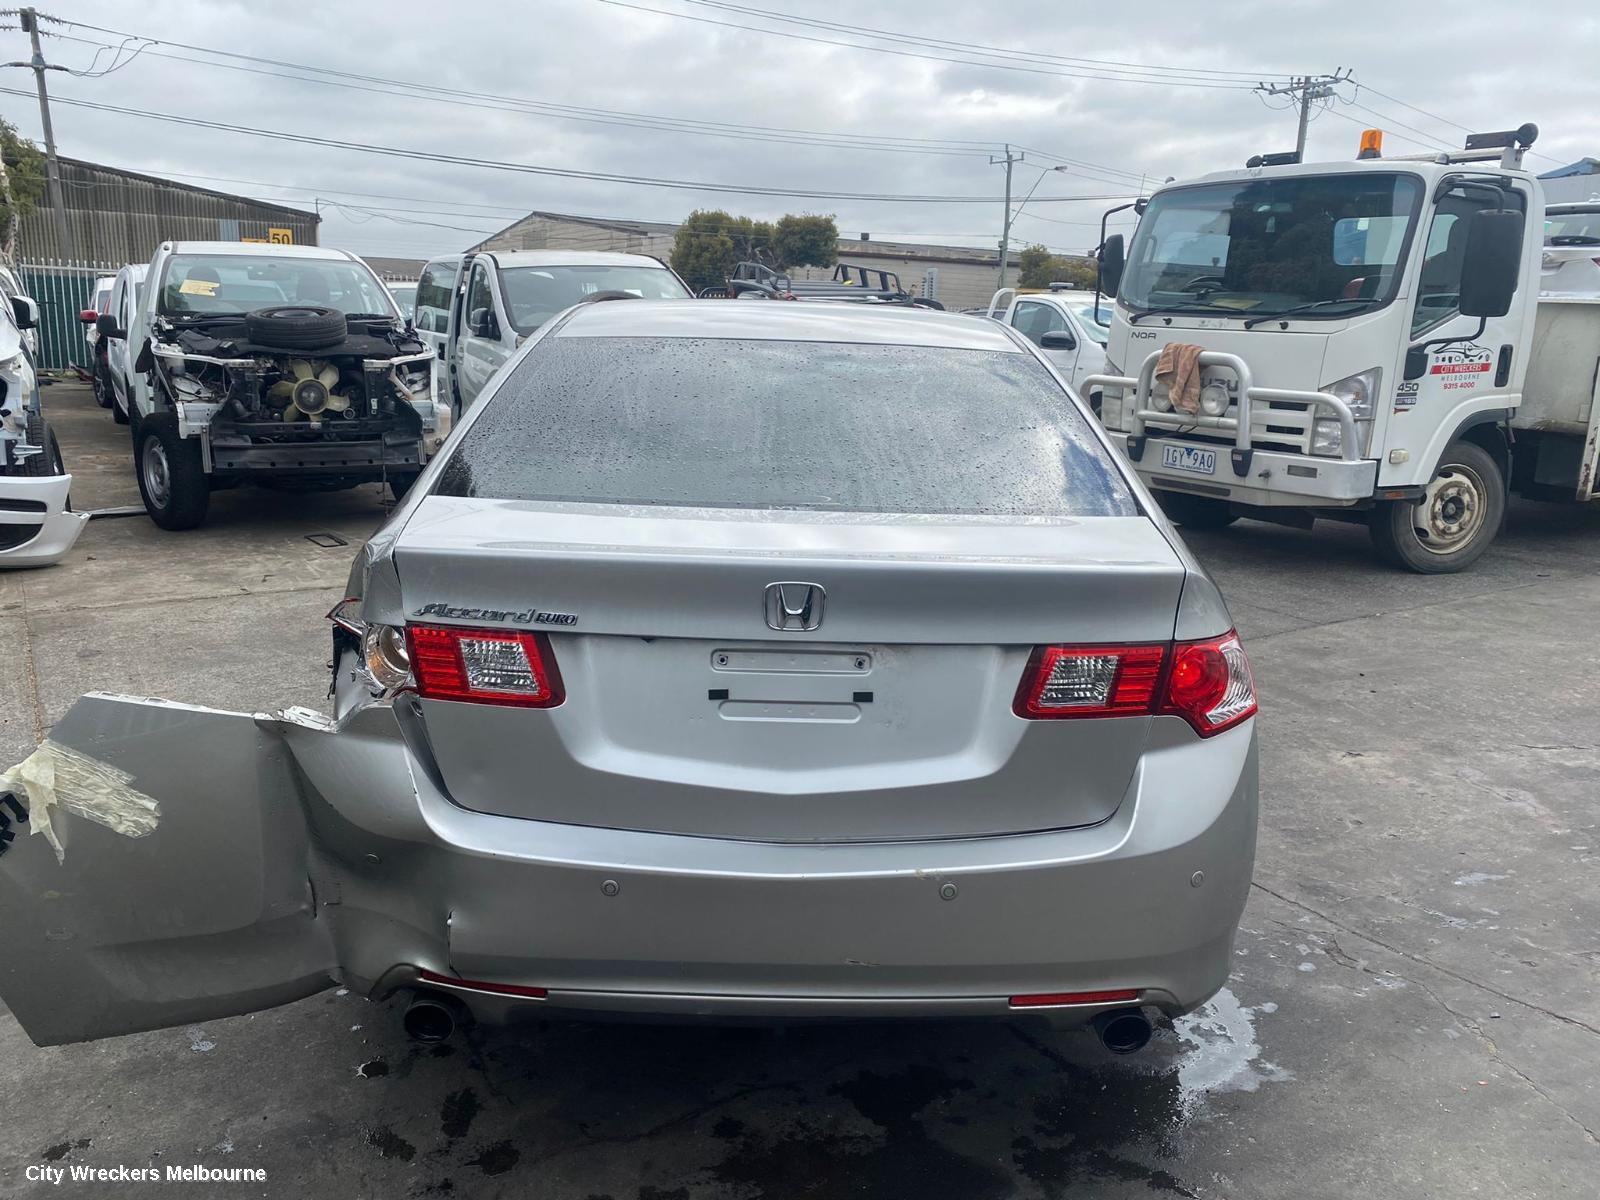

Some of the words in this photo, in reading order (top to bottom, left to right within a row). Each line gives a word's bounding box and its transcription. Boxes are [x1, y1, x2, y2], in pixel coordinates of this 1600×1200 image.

[271, 233, 290, 244] 50
[1440, 365, 1453, 373] CITY
[1454, 363, 1482, 372] WRECKERS
[1440, 373, 1480, 381] MELBOURNE
[1397, 382, 1420, 392] 450
[412, 603, 536, 624] Accord
[534, 612, 578, 626] EURO
